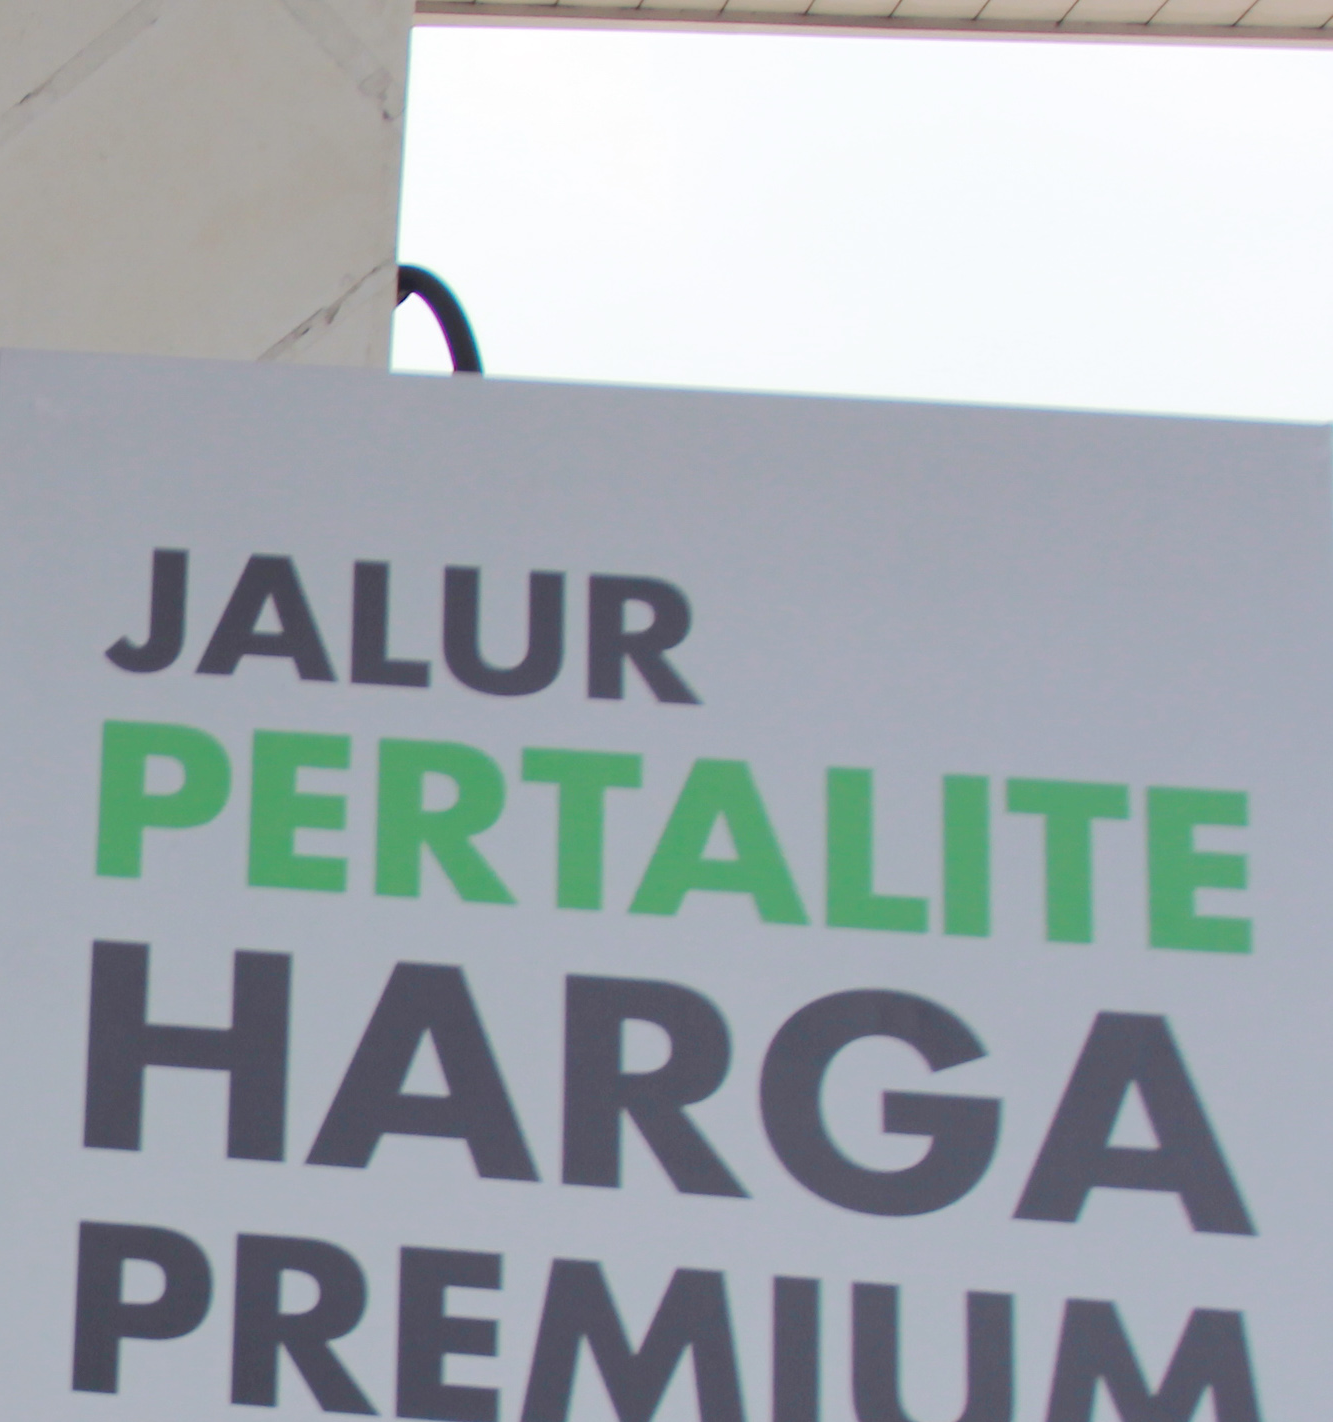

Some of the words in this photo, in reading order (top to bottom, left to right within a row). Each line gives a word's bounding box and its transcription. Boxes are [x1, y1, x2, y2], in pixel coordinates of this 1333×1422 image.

[103, 547, 702, 705] JALUR
[95, 719, 1253, 955] PERTALITE
[82, 940, 1259, 1236] HARGA
